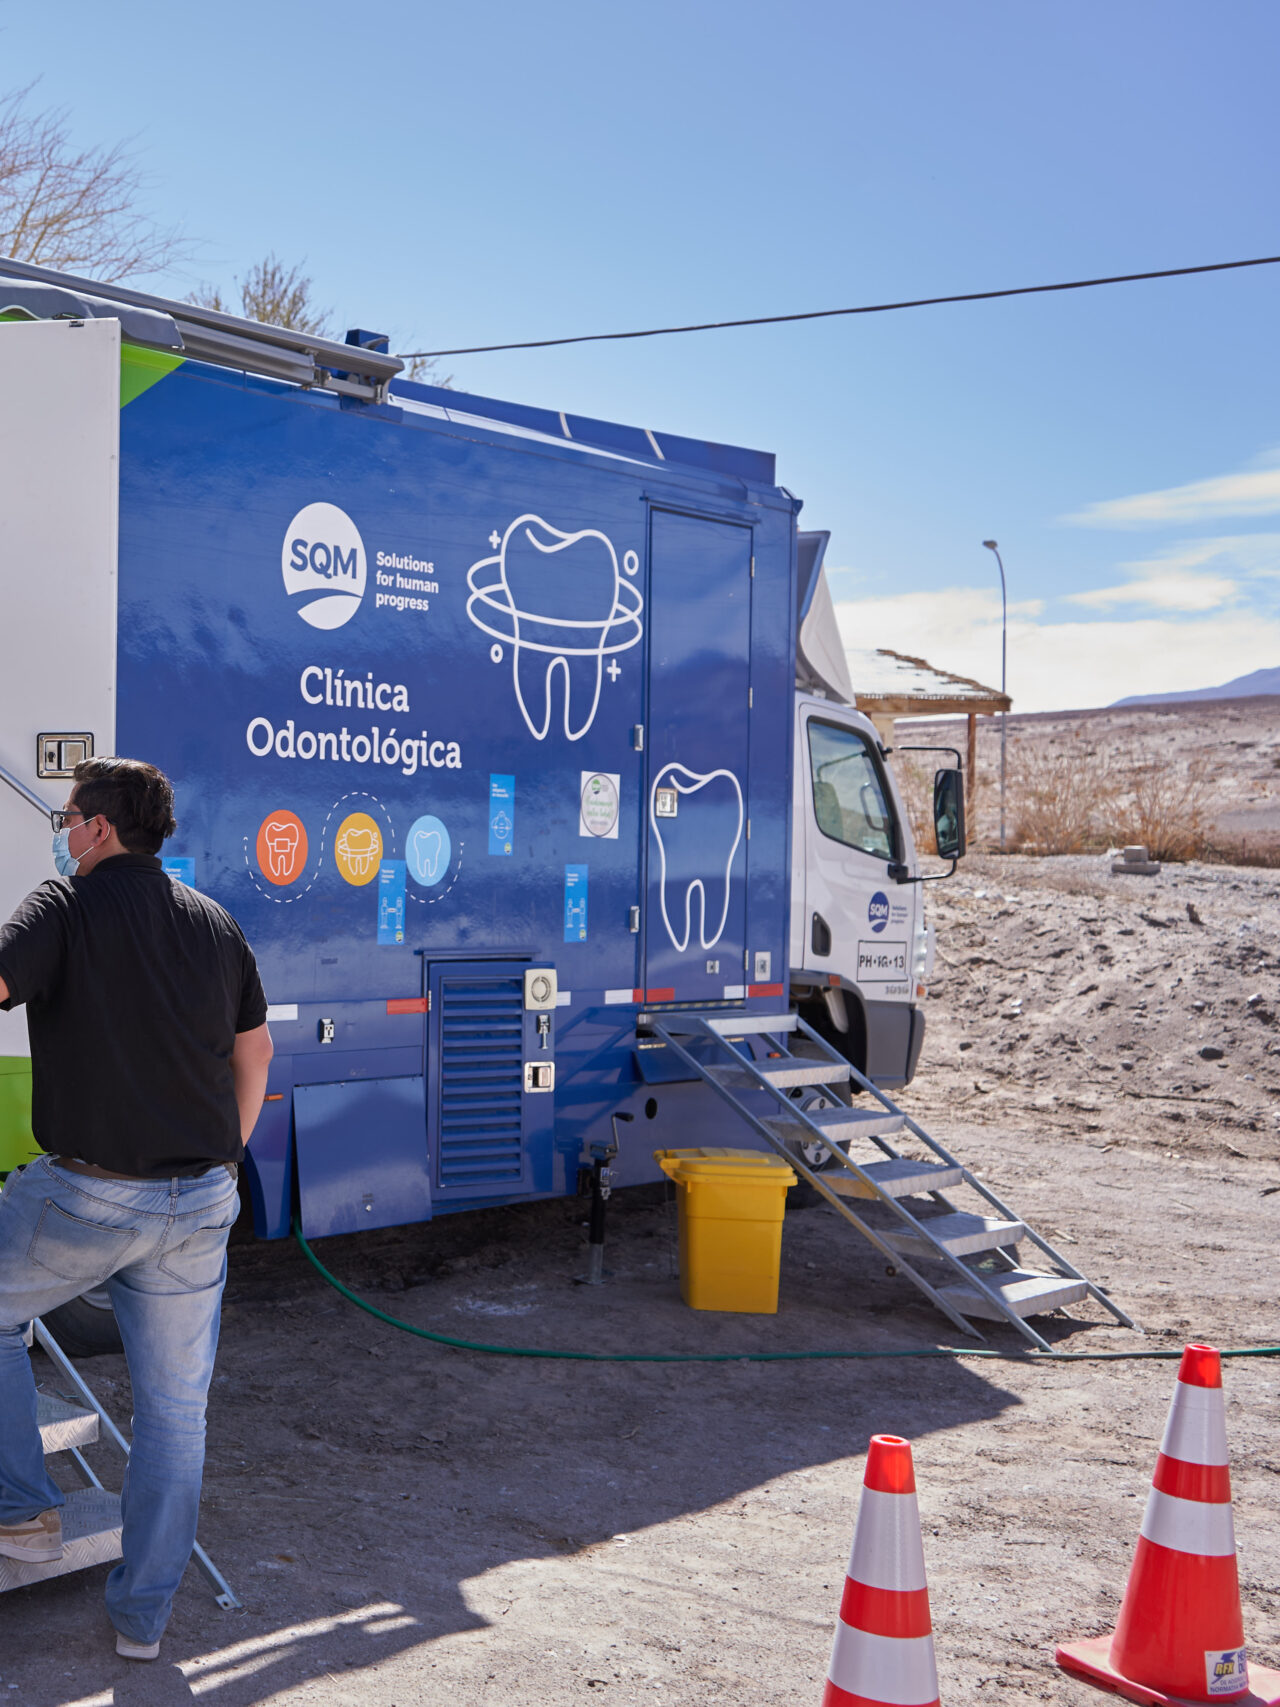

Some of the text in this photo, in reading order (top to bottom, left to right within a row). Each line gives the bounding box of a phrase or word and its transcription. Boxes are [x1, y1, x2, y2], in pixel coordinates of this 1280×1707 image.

[290, 538, 358, 579] SQM
[376, 551, 434, 574] Solutions
[375, 573, 439, 594] for human
[375, 593, 429, 612] progress
[300, 665, 409, 712] Clínica
[246, 716, 463, 776] Odontológica
[869, 903, 888, 917] SQM
